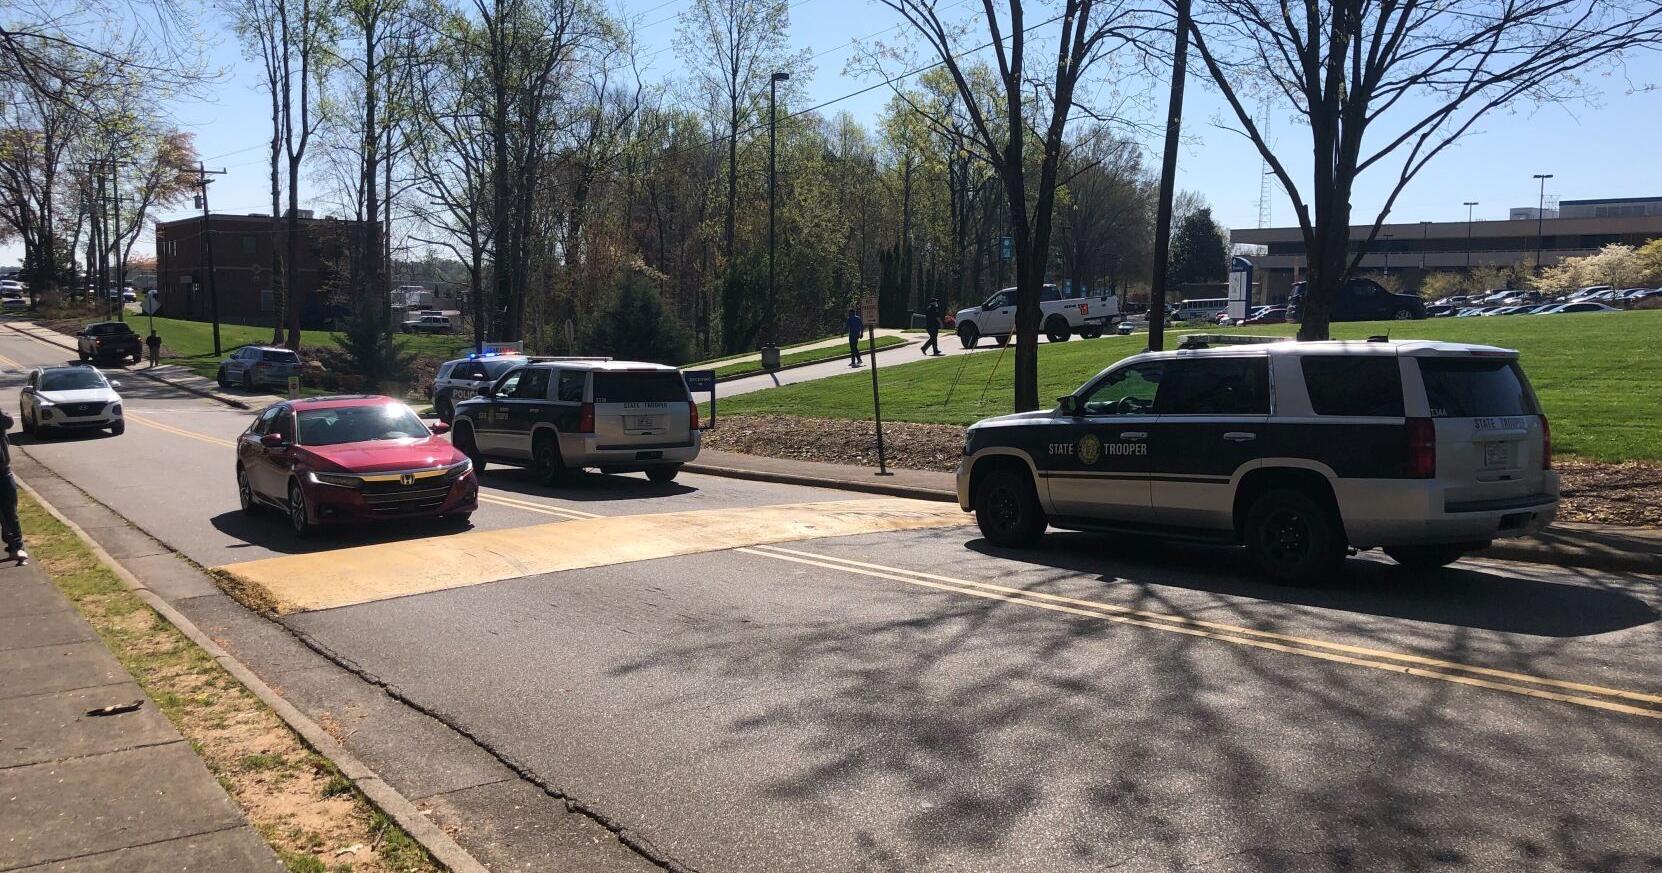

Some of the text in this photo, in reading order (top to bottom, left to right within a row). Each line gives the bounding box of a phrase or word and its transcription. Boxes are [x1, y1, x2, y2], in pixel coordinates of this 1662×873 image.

[1474, 418, 1496, 429] STATE
[1048, 443, 1147, 455] STATE TROOPER
